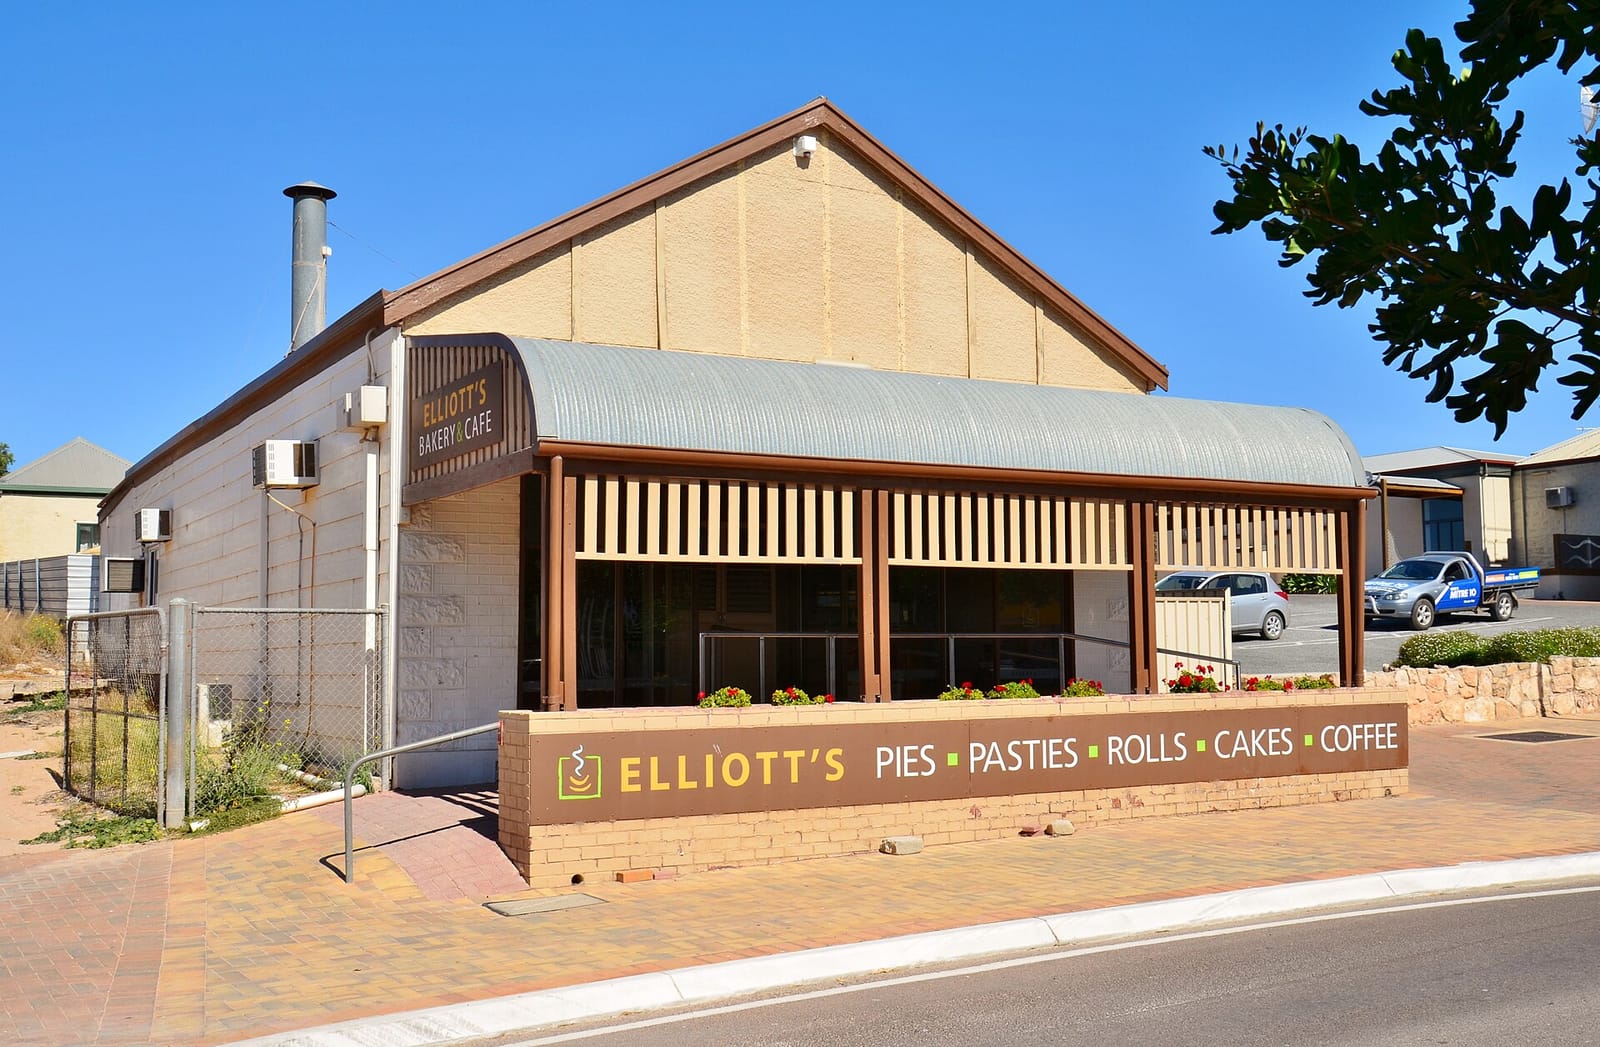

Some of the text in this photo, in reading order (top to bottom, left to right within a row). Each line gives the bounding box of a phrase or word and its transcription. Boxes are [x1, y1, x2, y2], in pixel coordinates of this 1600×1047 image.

[423, 378, 487, 428] ELLIOTT'S
[419, 423, 456, 457] BAKERY
[464, 409, 492, 440] CAFE
[1469, 587, 1477, 597] 10
[620, 722, 1398, 793] ELLIOTT'S PIES PASTIES ROLLS CAKES COFFEE
